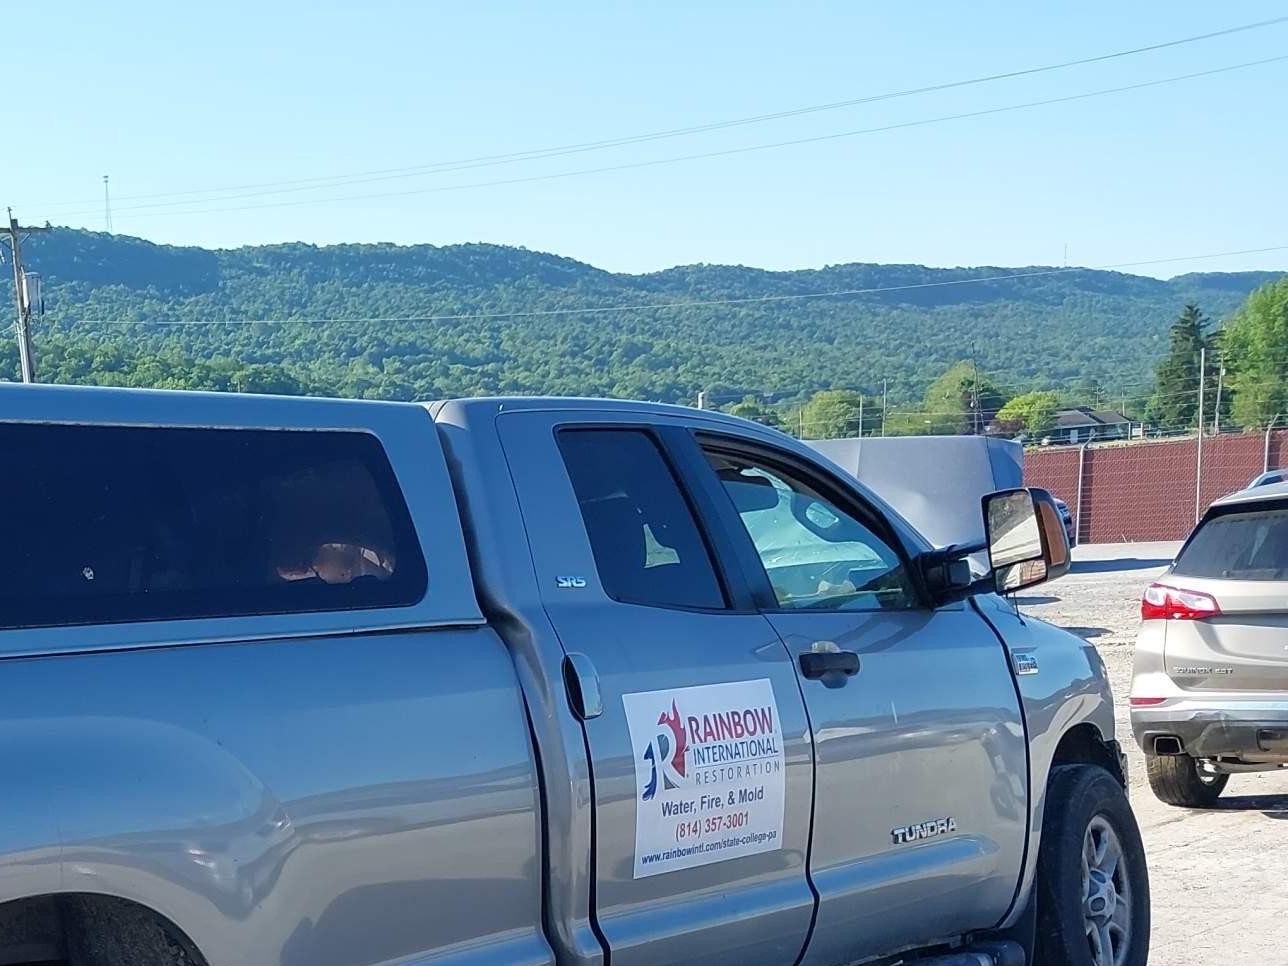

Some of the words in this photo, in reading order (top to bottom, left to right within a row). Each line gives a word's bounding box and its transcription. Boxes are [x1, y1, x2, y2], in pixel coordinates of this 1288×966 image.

[556, 576, 587, 588] SR5
[688, 707, 773, 744] RAINBOW
[693, 738, 779, 766] INTERNATIONAL
[695, 760, 780, 785] RESTORATION
[662, 800, 697, 817] Water,
[700, 795, 724, 811] Fire,
[728, 790, 736, 806] &
[739, 786, 764, 804] Mold
[675, 819, 702, 842] (814)
[705, 811, 749, 833] 357-3001
[892, 817, 957, 844] TUNDRA
[641, 829, 777, 865] www.rainbowintl.com/state-college-pa
